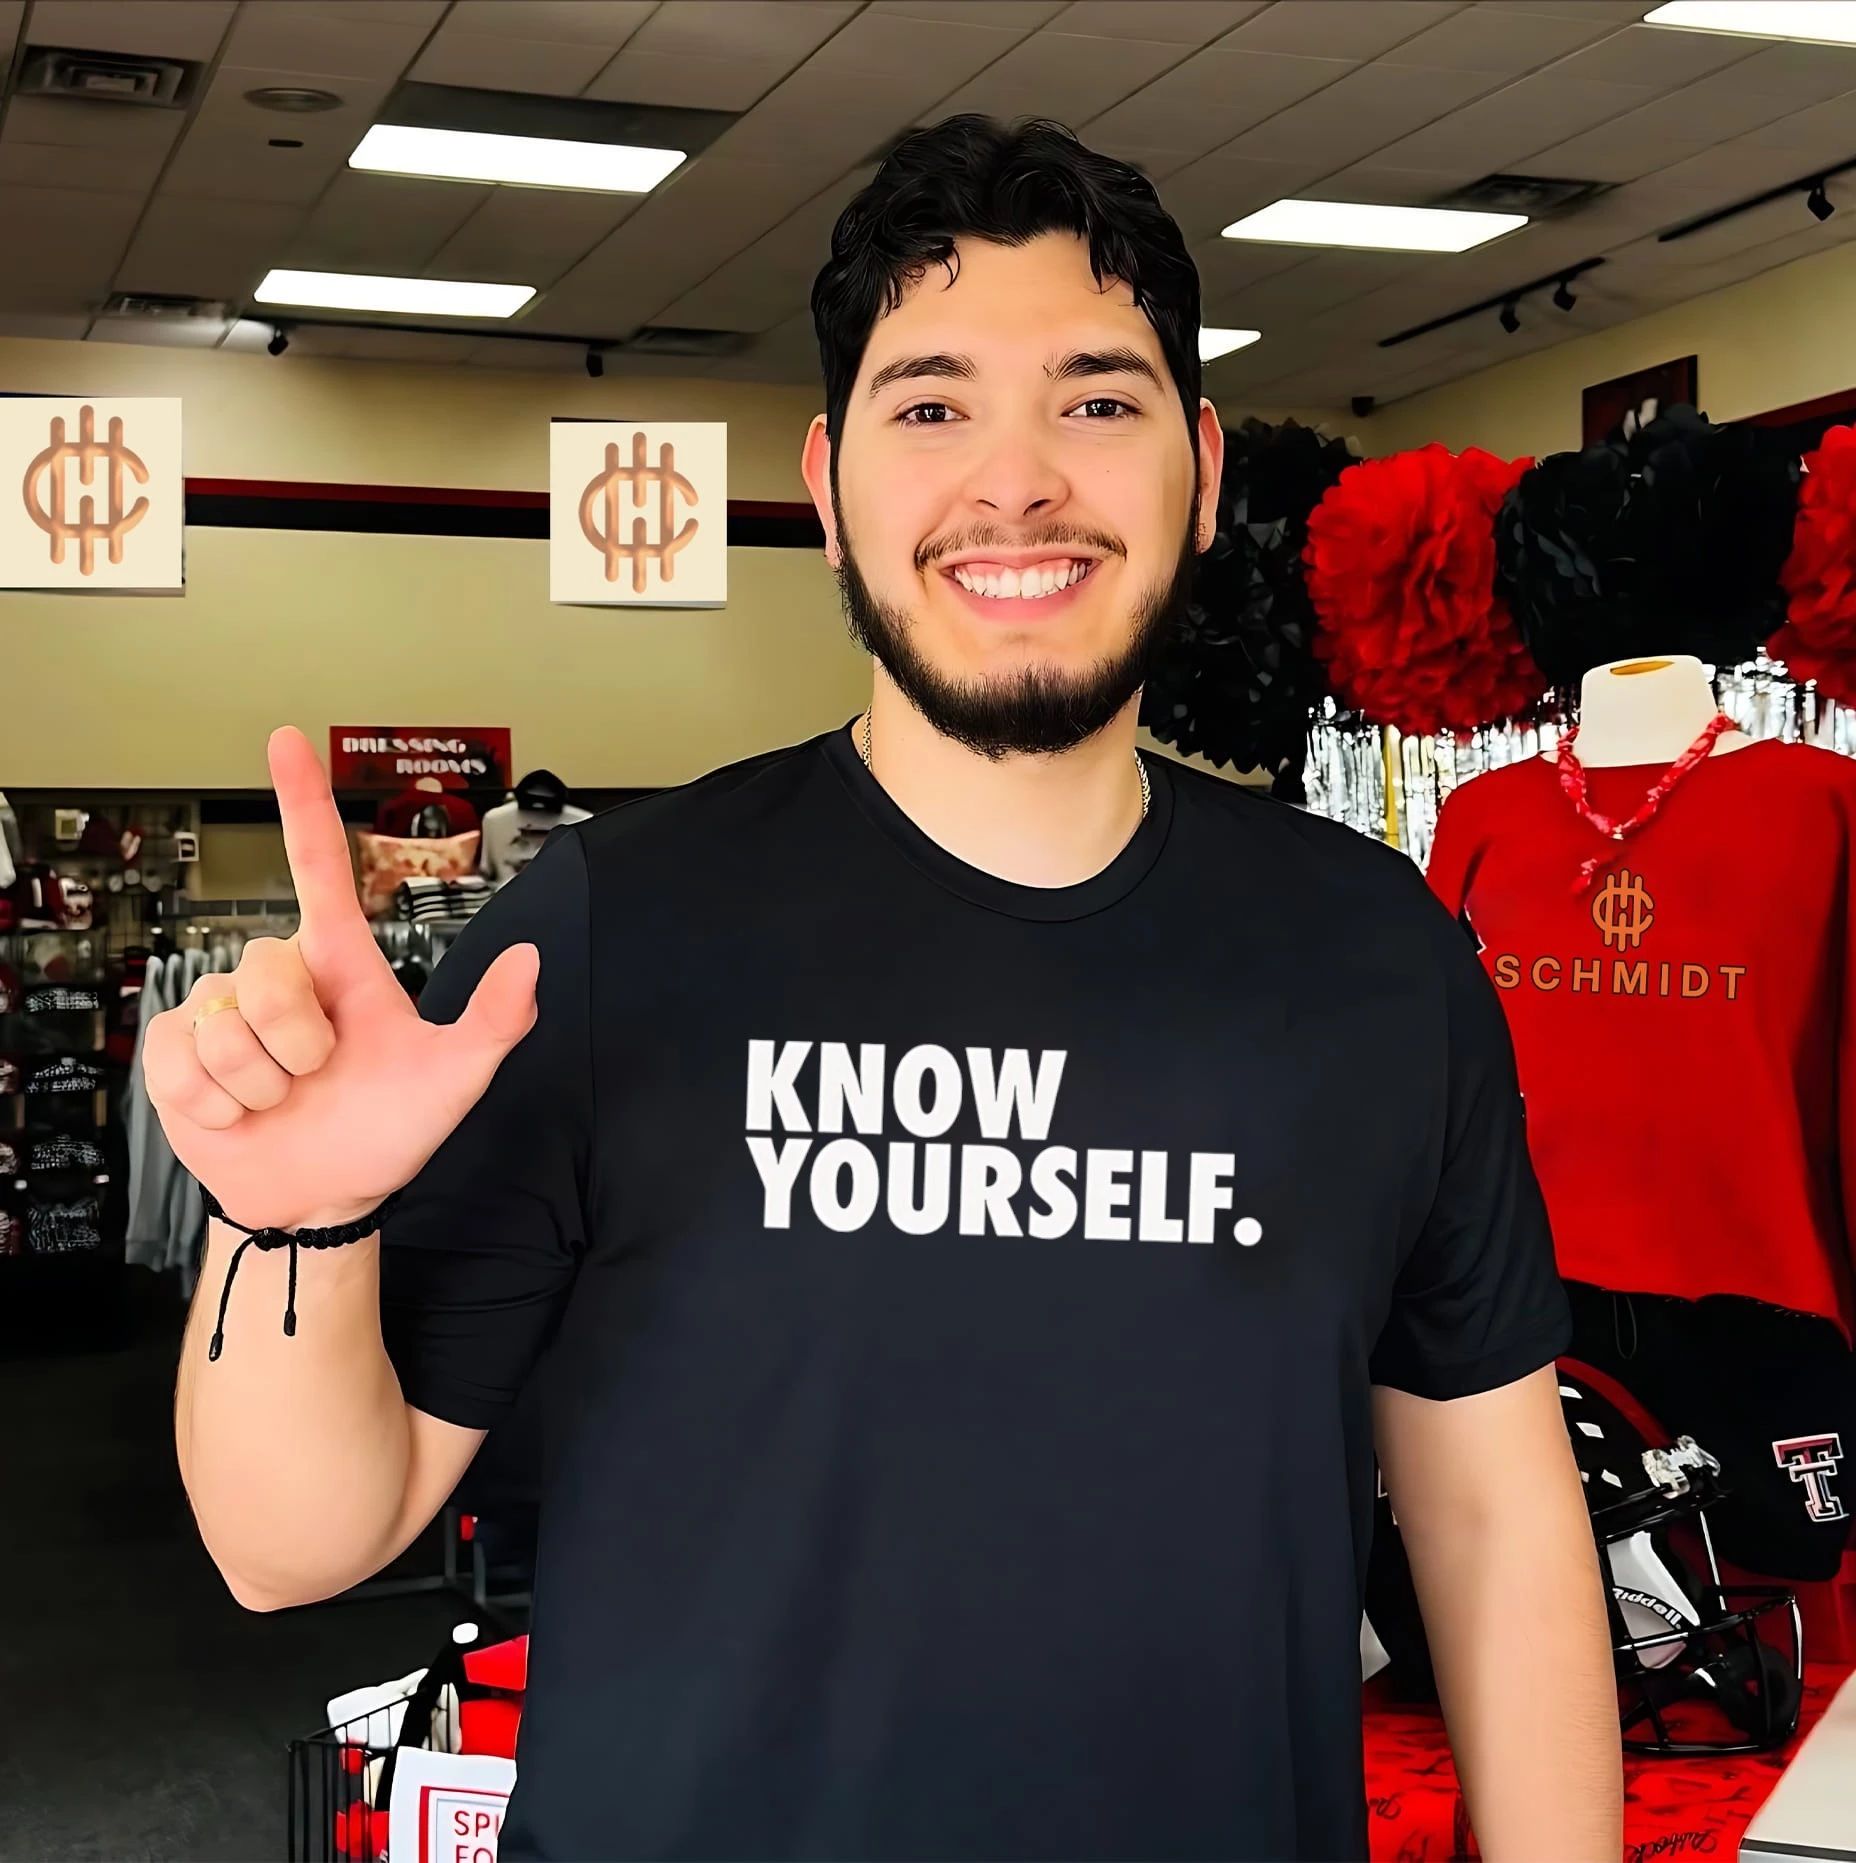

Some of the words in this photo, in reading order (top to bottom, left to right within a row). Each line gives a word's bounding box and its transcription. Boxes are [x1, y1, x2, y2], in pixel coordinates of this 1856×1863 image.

[1494, 954, 1747, 999] SCHMIDT
[745, 1039, 1067, 1140] KNOW
[745, 1136, 1262, 1246] YOURSELF.
